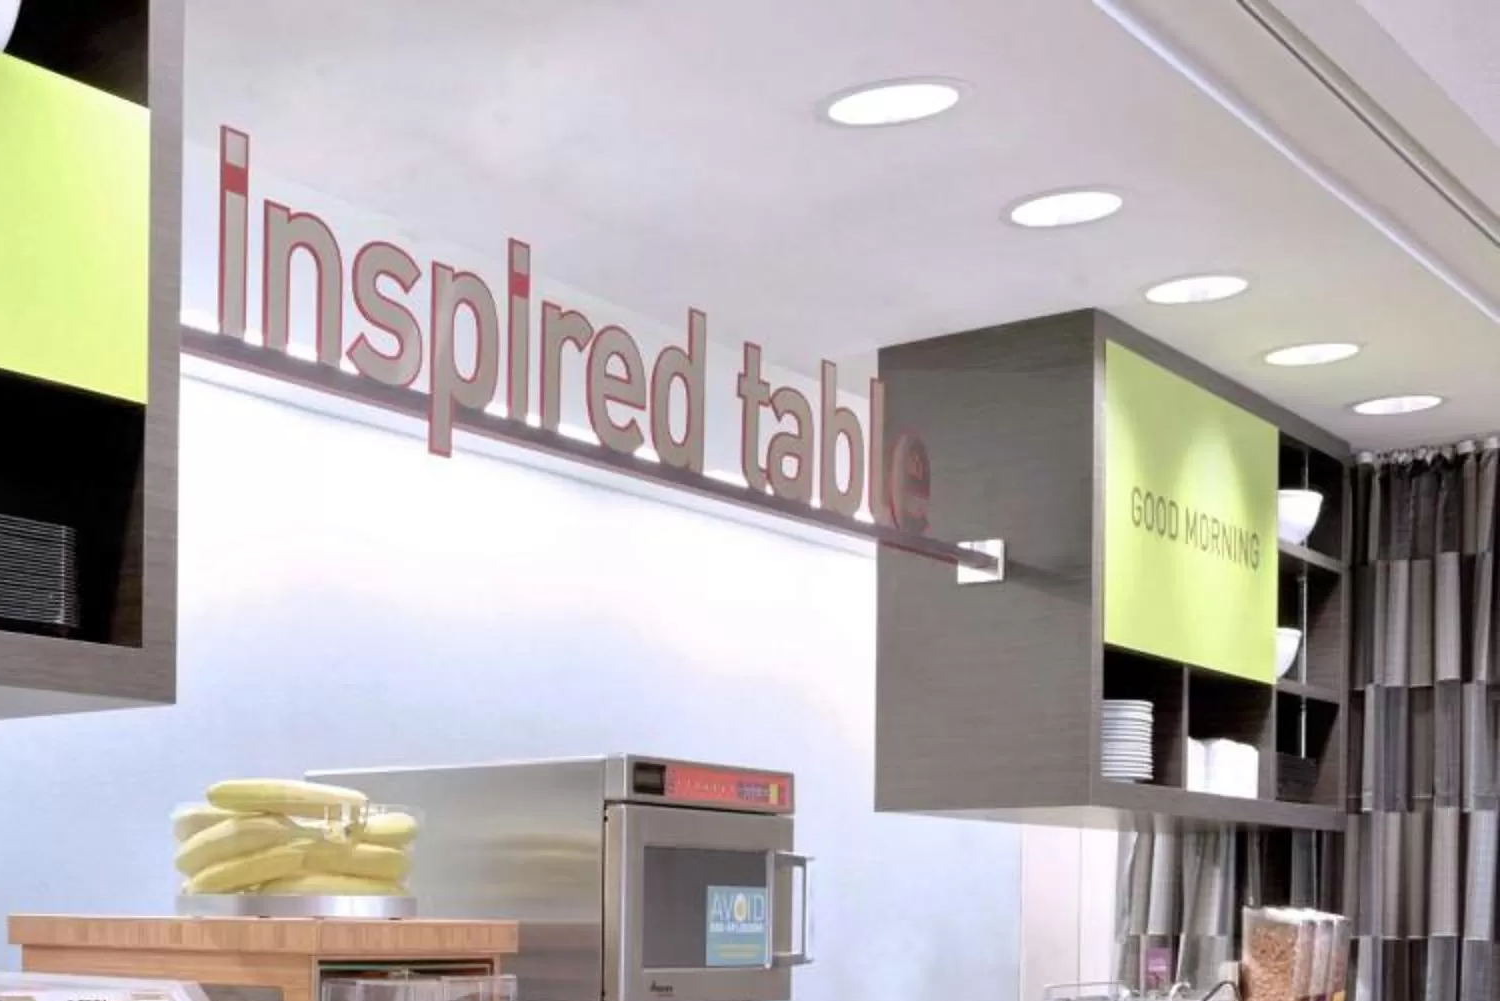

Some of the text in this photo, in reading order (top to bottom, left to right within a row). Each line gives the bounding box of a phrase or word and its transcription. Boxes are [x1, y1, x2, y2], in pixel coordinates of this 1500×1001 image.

[218, 124, 932, 535] inspired table
[1131, 485, 1261, 571] GOOD MORNING
[710, 891, 765, 922] AVOID
